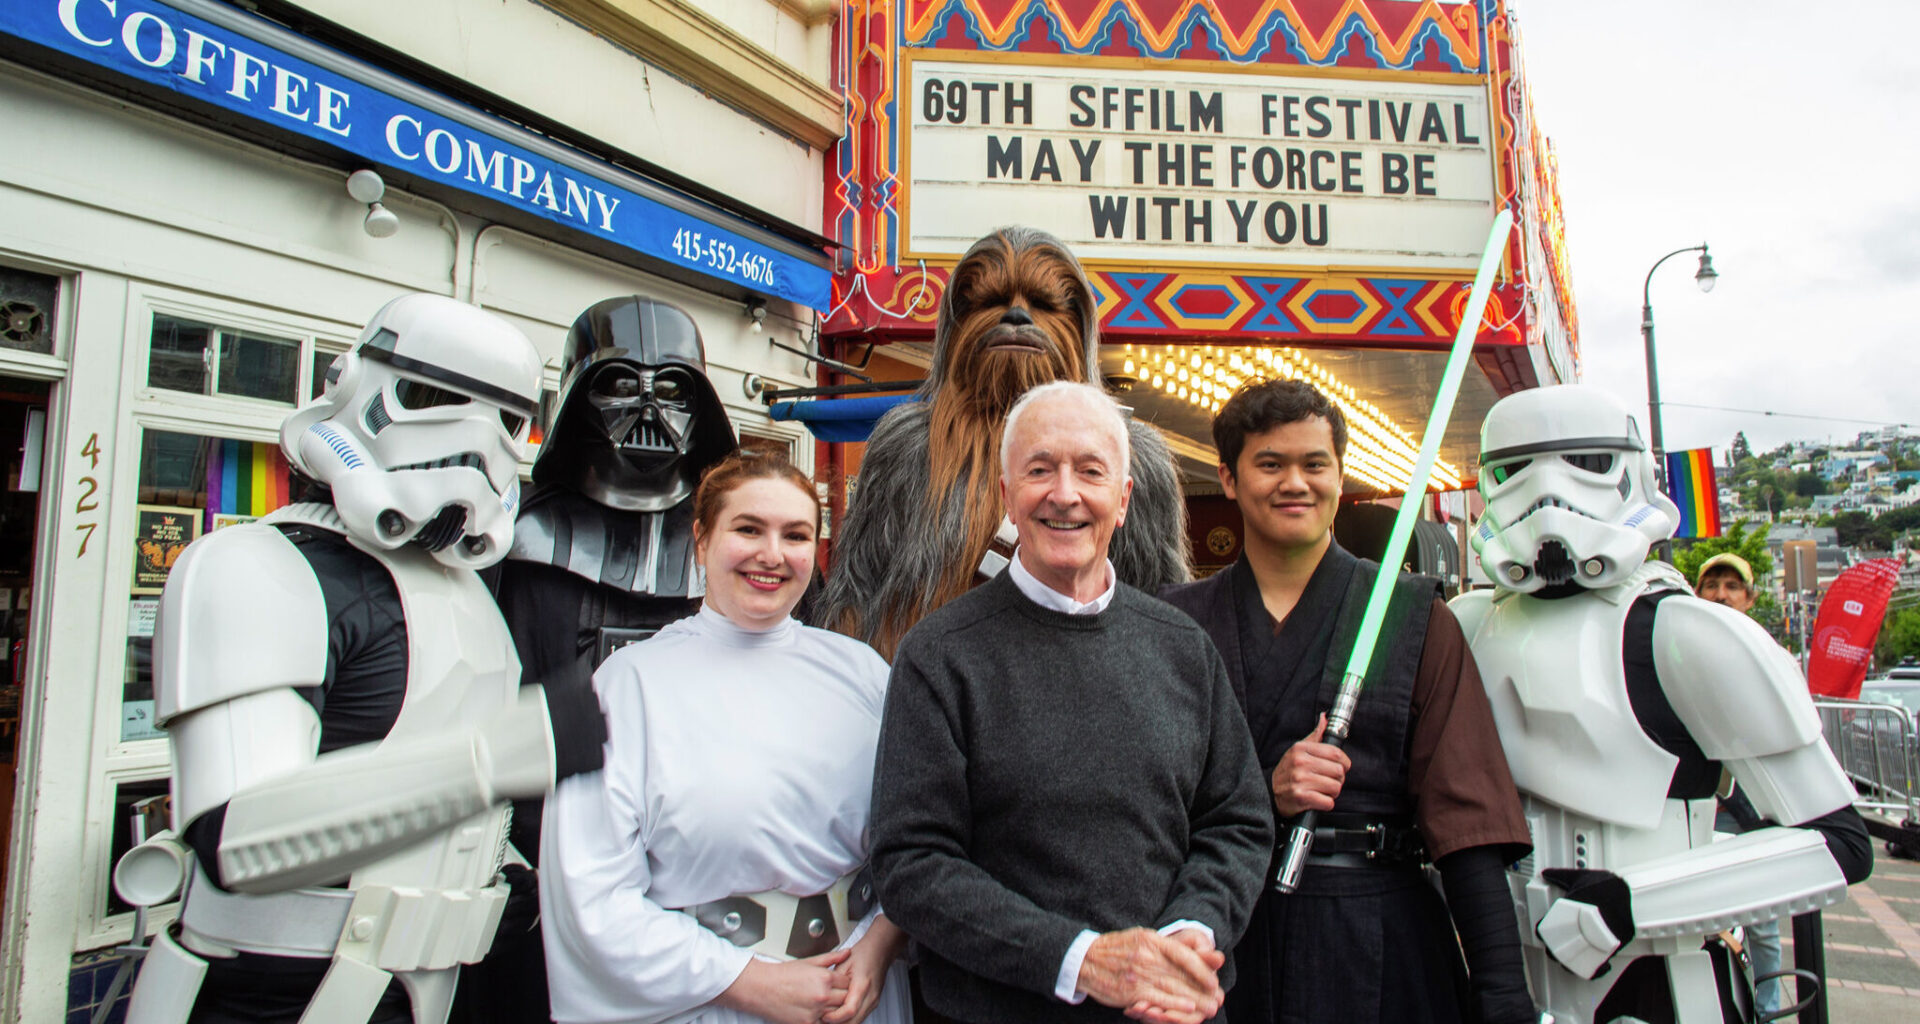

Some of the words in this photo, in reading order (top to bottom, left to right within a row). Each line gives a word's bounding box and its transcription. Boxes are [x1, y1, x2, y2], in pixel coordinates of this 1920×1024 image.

[58, 0, 352, 137] COFFEE
[385, 114, 622, 233] COMPANY
[923, 78, 1033, 124] 69TH
[1070, 85, 1223, 133] SFFILM
[1261, 94, 1481, 145] FESTIVAL
[987, 135, 1102, 182] MAY
[1124, 141, 1214, 187] THE
[1230, 146, 1364, 193] FORCE
[1382, 152, 1437, 196] BE
[1089, 195, 1212, 243] WITH
[1226, 199, 1328, 246] YOU
[671, 226, 775, 287] 415-552-6676
[76, 432, 102, 559] 427
